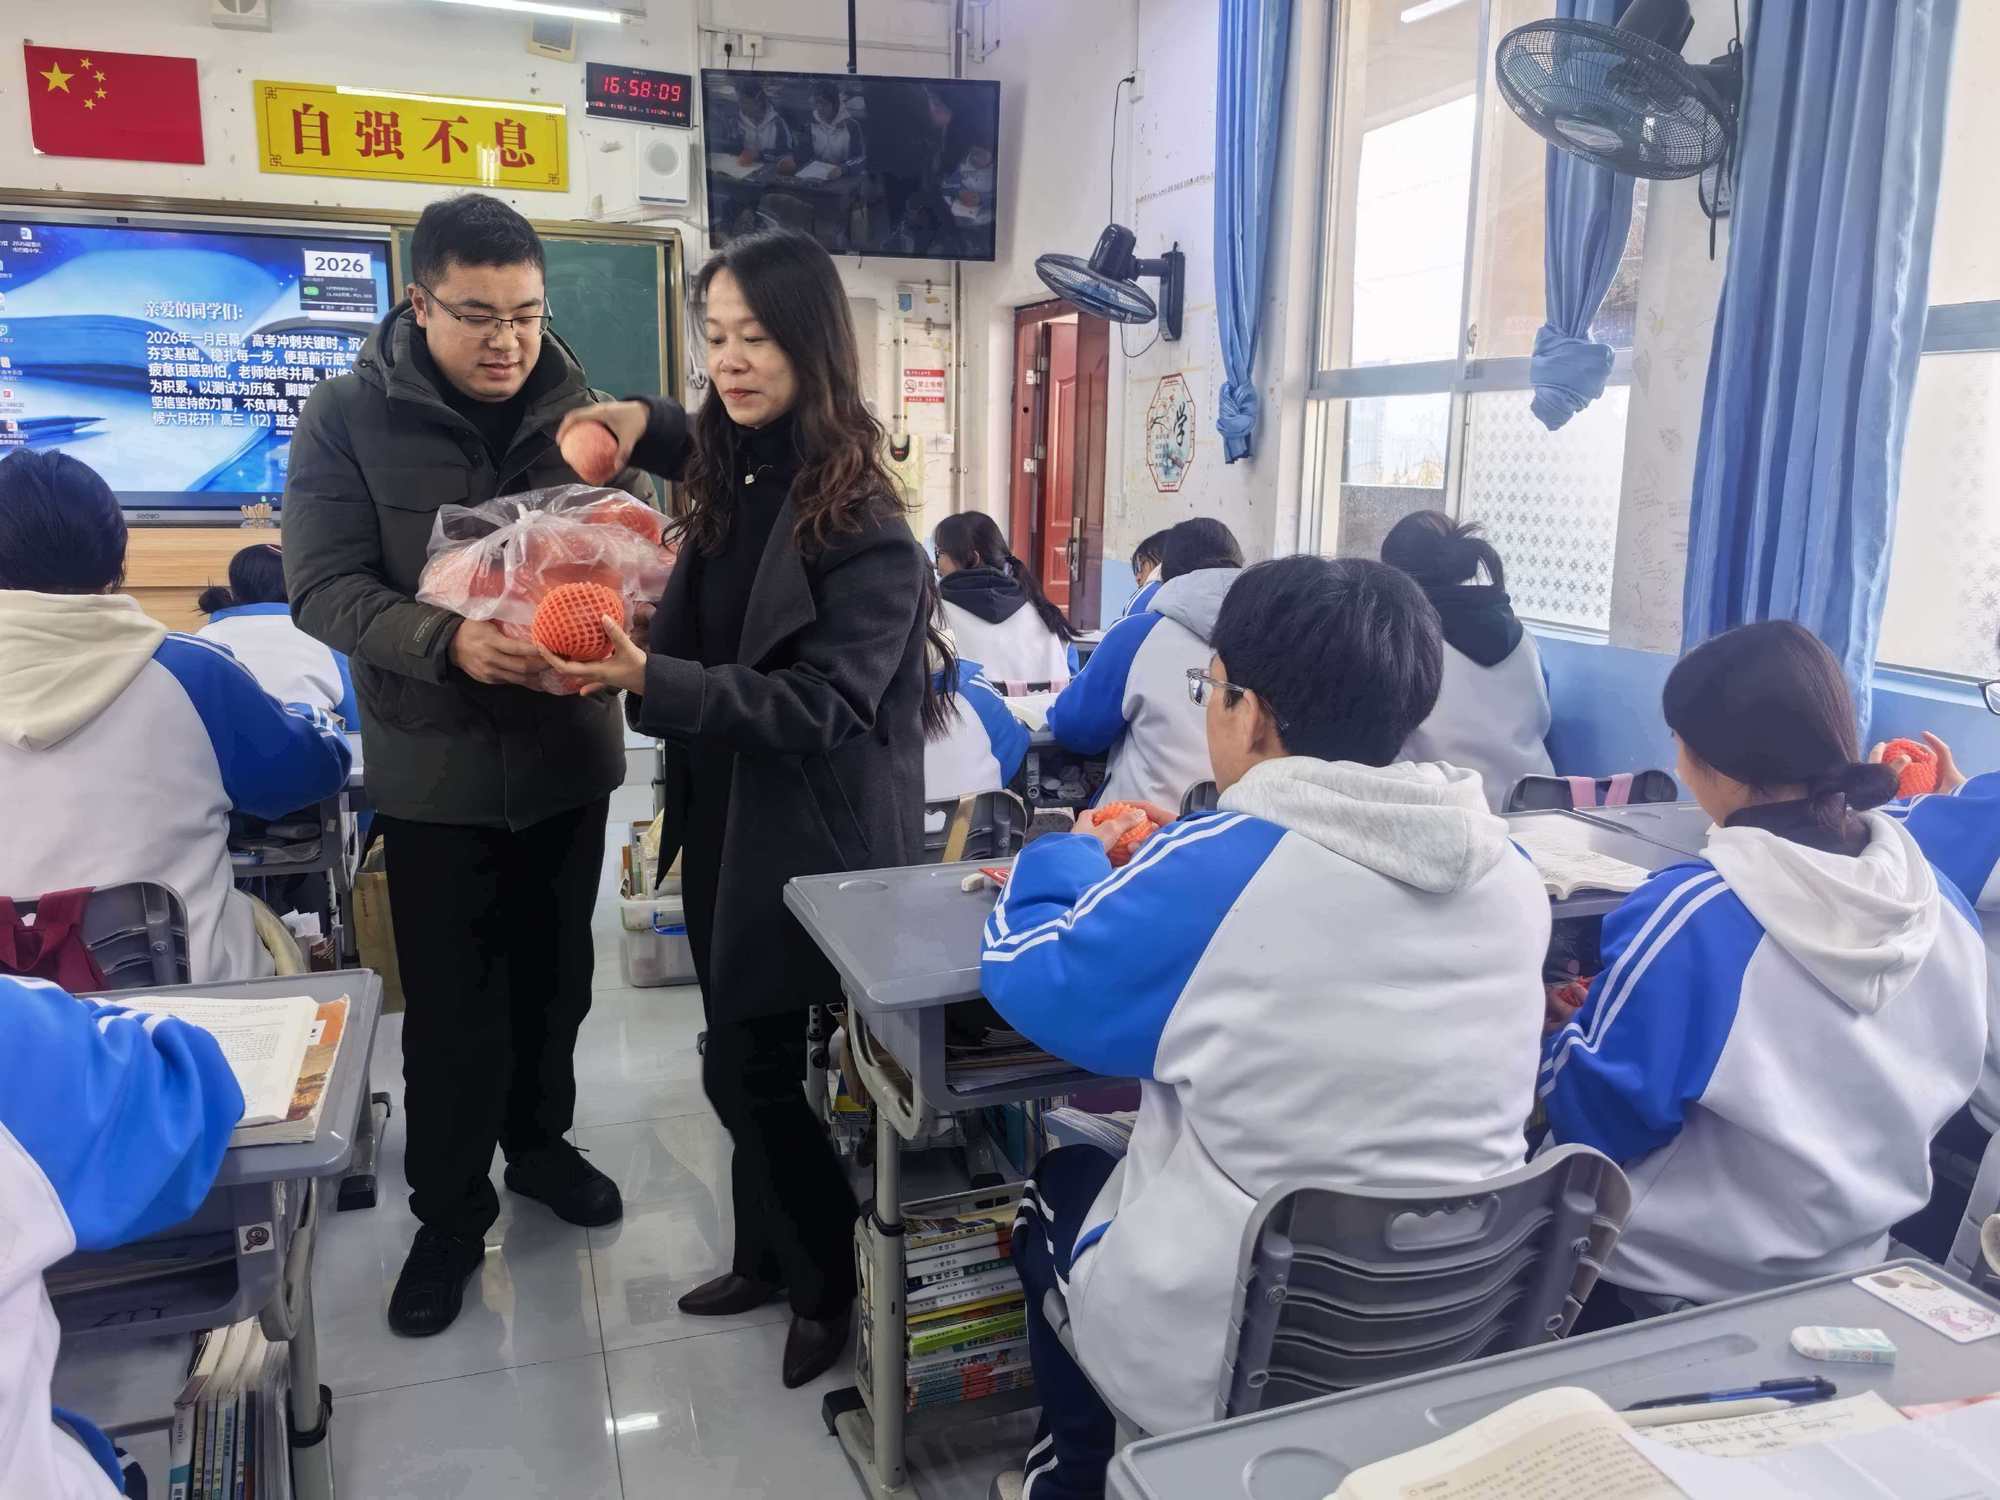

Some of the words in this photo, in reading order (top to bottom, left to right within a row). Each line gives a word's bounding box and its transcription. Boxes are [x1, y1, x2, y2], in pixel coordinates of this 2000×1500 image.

[602, 76, 681, 102] 16:58:09
[292, 103, 536, 168] 自强不息
[315, 256, 364, 273] 2026
[148, 364, 355, 382] 疲惫困惑别怕，老师始终并肩。以练
[150, 380, 314, 398] 为积累，以测试为历练，脚踏
